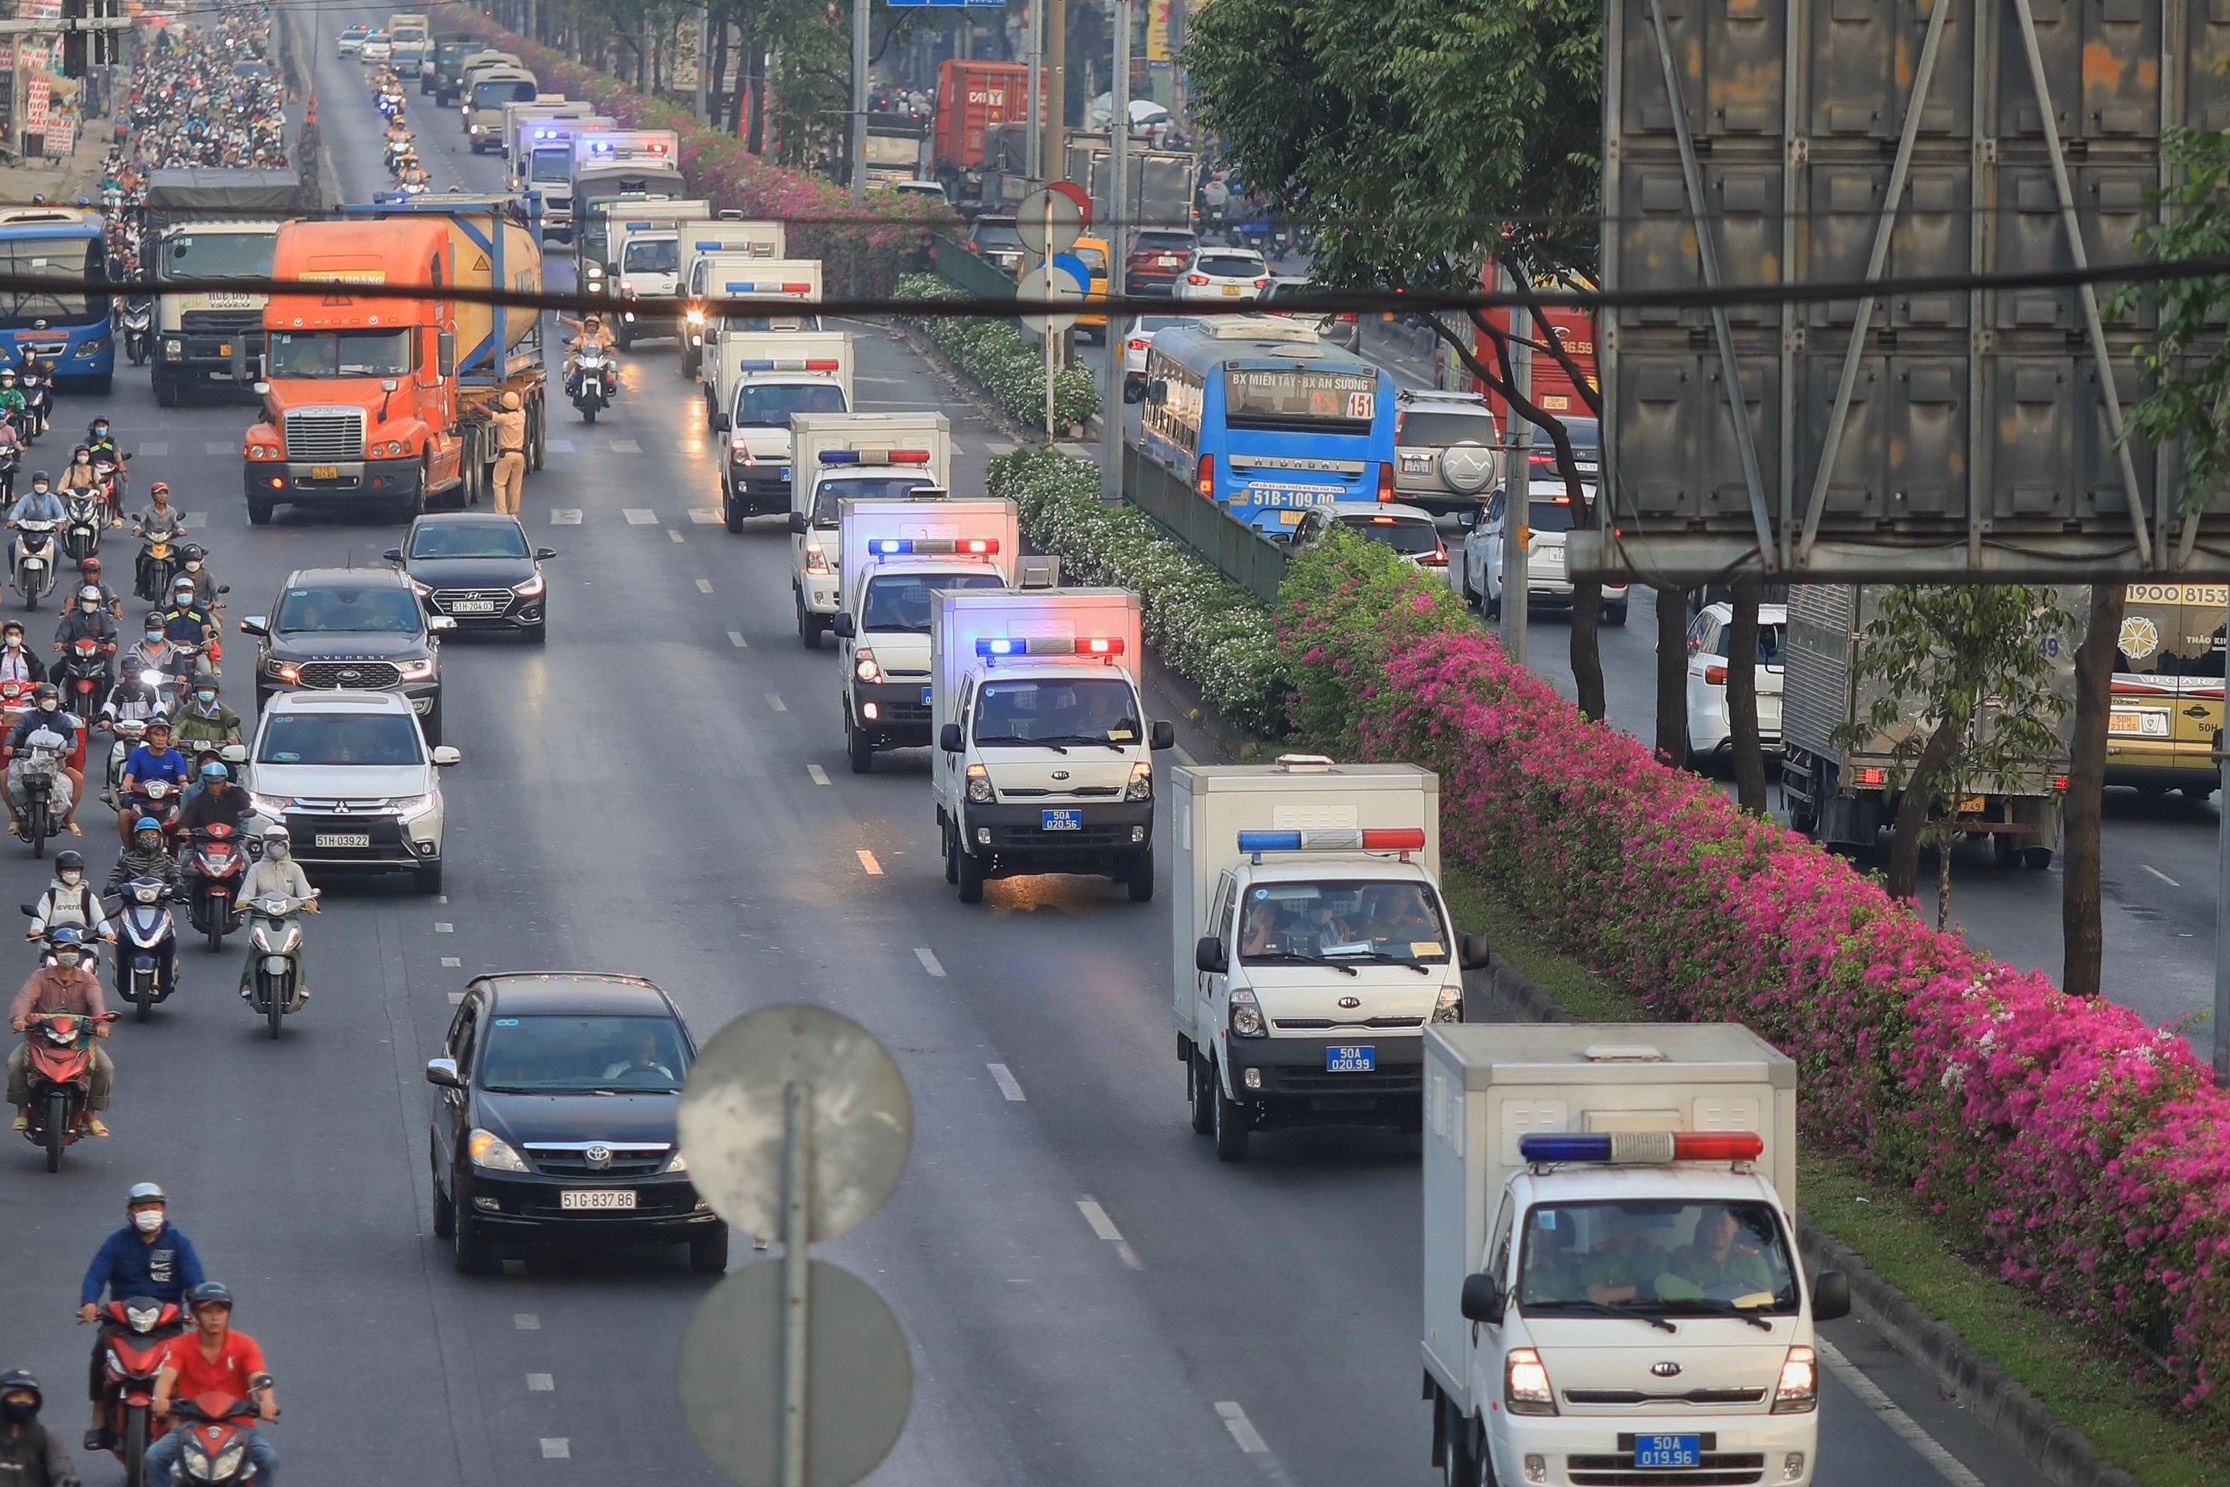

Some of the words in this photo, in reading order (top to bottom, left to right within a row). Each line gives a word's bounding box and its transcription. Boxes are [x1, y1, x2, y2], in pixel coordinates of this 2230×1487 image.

[1232, 374, 1247, 385] BX
[1302, 377, 1316, 389] BX
[1318, 378, 1333, 389] AN
[1351, 395, 1372, 417] 151
[1254, 458, 1341, 471] HYUNDAI
[2128, 585, 2180, 601] 1900
[2185, 588, 2227, 604] 8153
[2198, 723, 2218, 733] 50H
[1053, 811, 1071, 820] 50A
[1046, 820, 1078, 829] 020.56
[1340, 998, 1358, 1006] KIA
[1340, 1048, 1361, 1059] 50A
[1331, 1059, 1370, 1070] 020.99
[563, 1193, 633, 1208] 51G-837.86
[1654, 1363, 1678, 1374] KIA
[1653, 1436, 1681, 1450] 50A
[1642, 1451, 1693, 1465] 019.96
